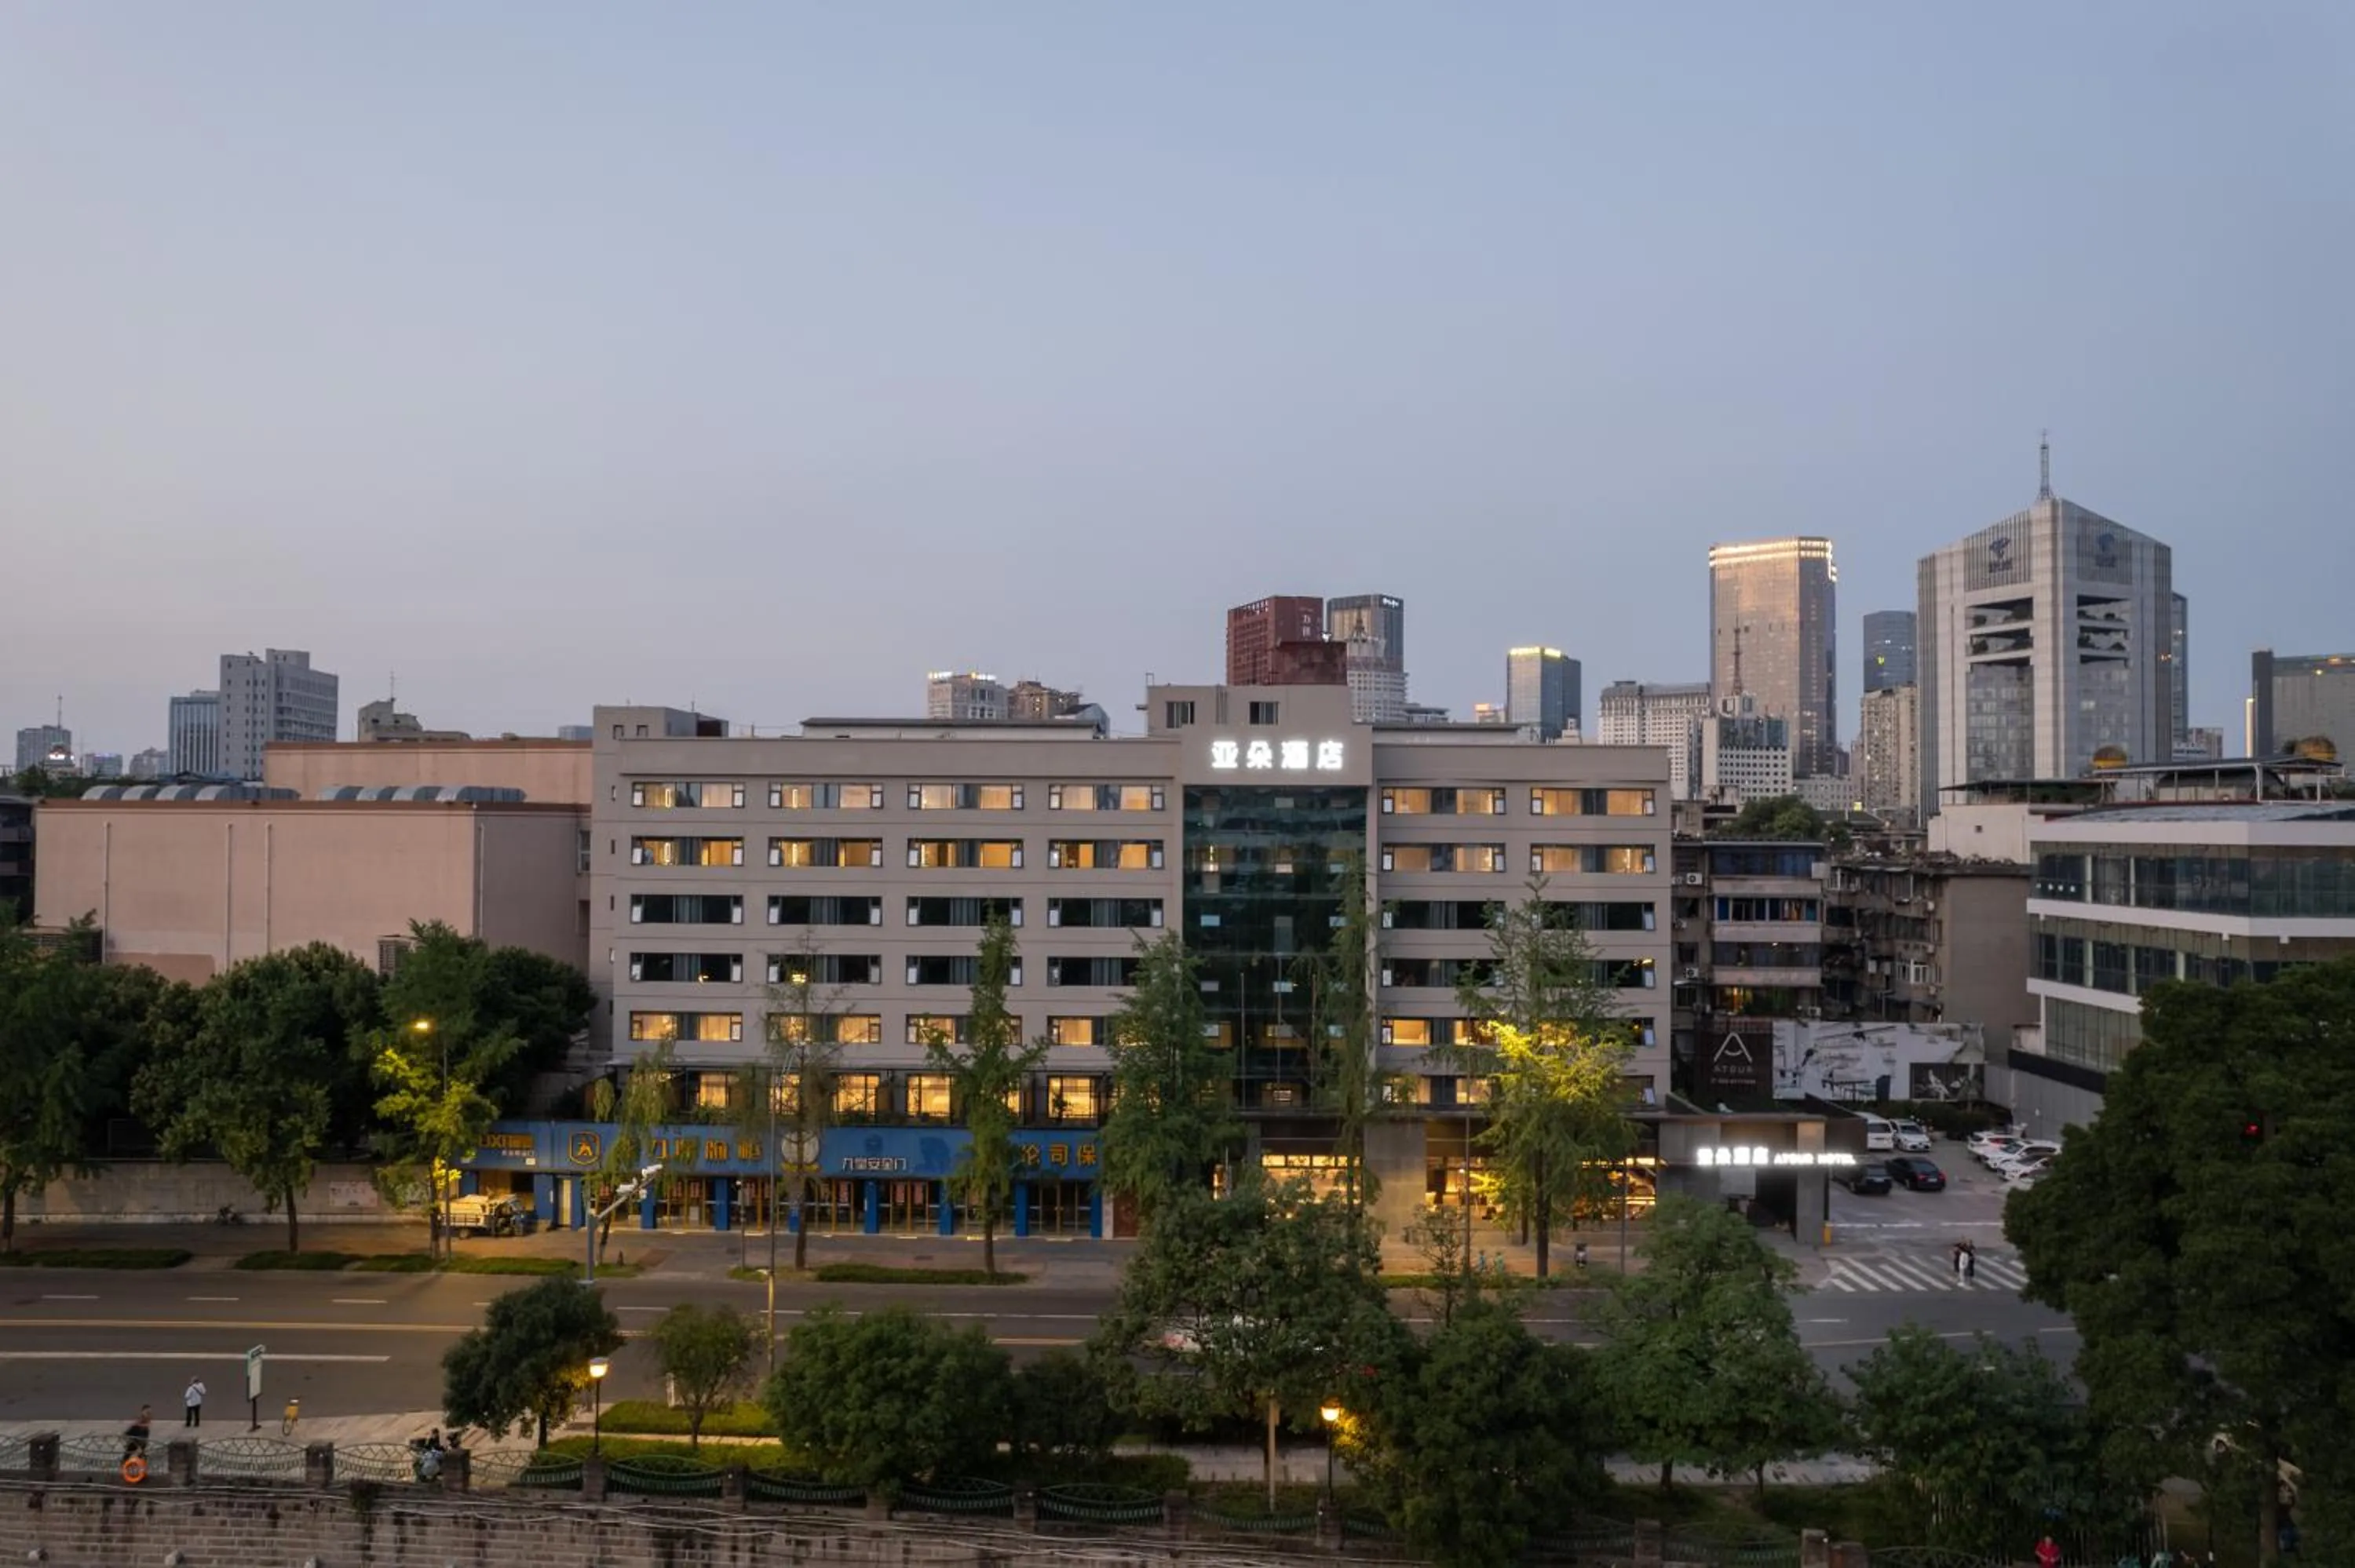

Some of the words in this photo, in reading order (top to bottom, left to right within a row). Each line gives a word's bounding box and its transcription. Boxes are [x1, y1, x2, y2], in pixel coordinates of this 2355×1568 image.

[1211, 740, 1343, 769] 亚朵酒店
[1773, 1153, 1813, 1165] ATOUR
[1817, 1153, 1856, 1165] HOTEL
